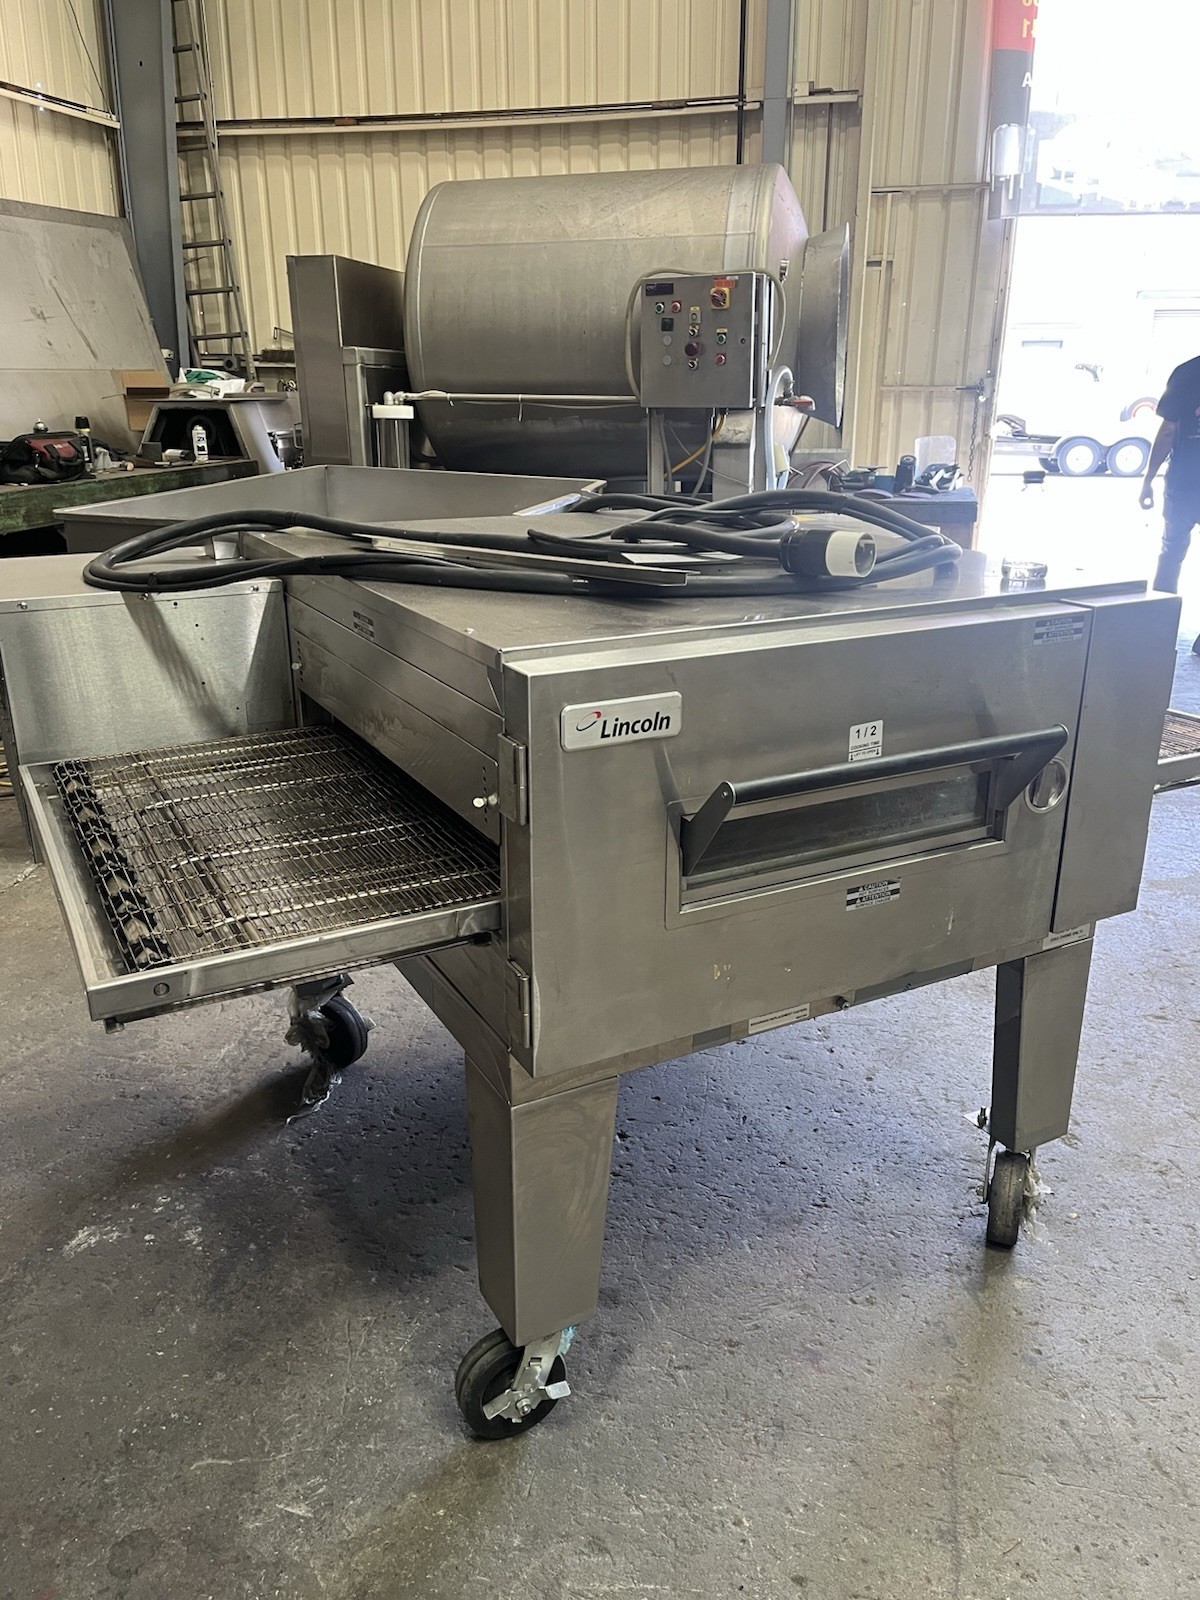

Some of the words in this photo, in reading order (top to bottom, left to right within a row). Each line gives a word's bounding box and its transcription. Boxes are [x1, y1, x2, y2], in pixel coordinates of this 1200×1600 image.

[1047, 629, 1075, 637] ATTENTION
[600, 711, 671, 739] Lincoln
[863, 880, 888, 891] CAUTION
[862, 891, 891, 902] ATTENTION
